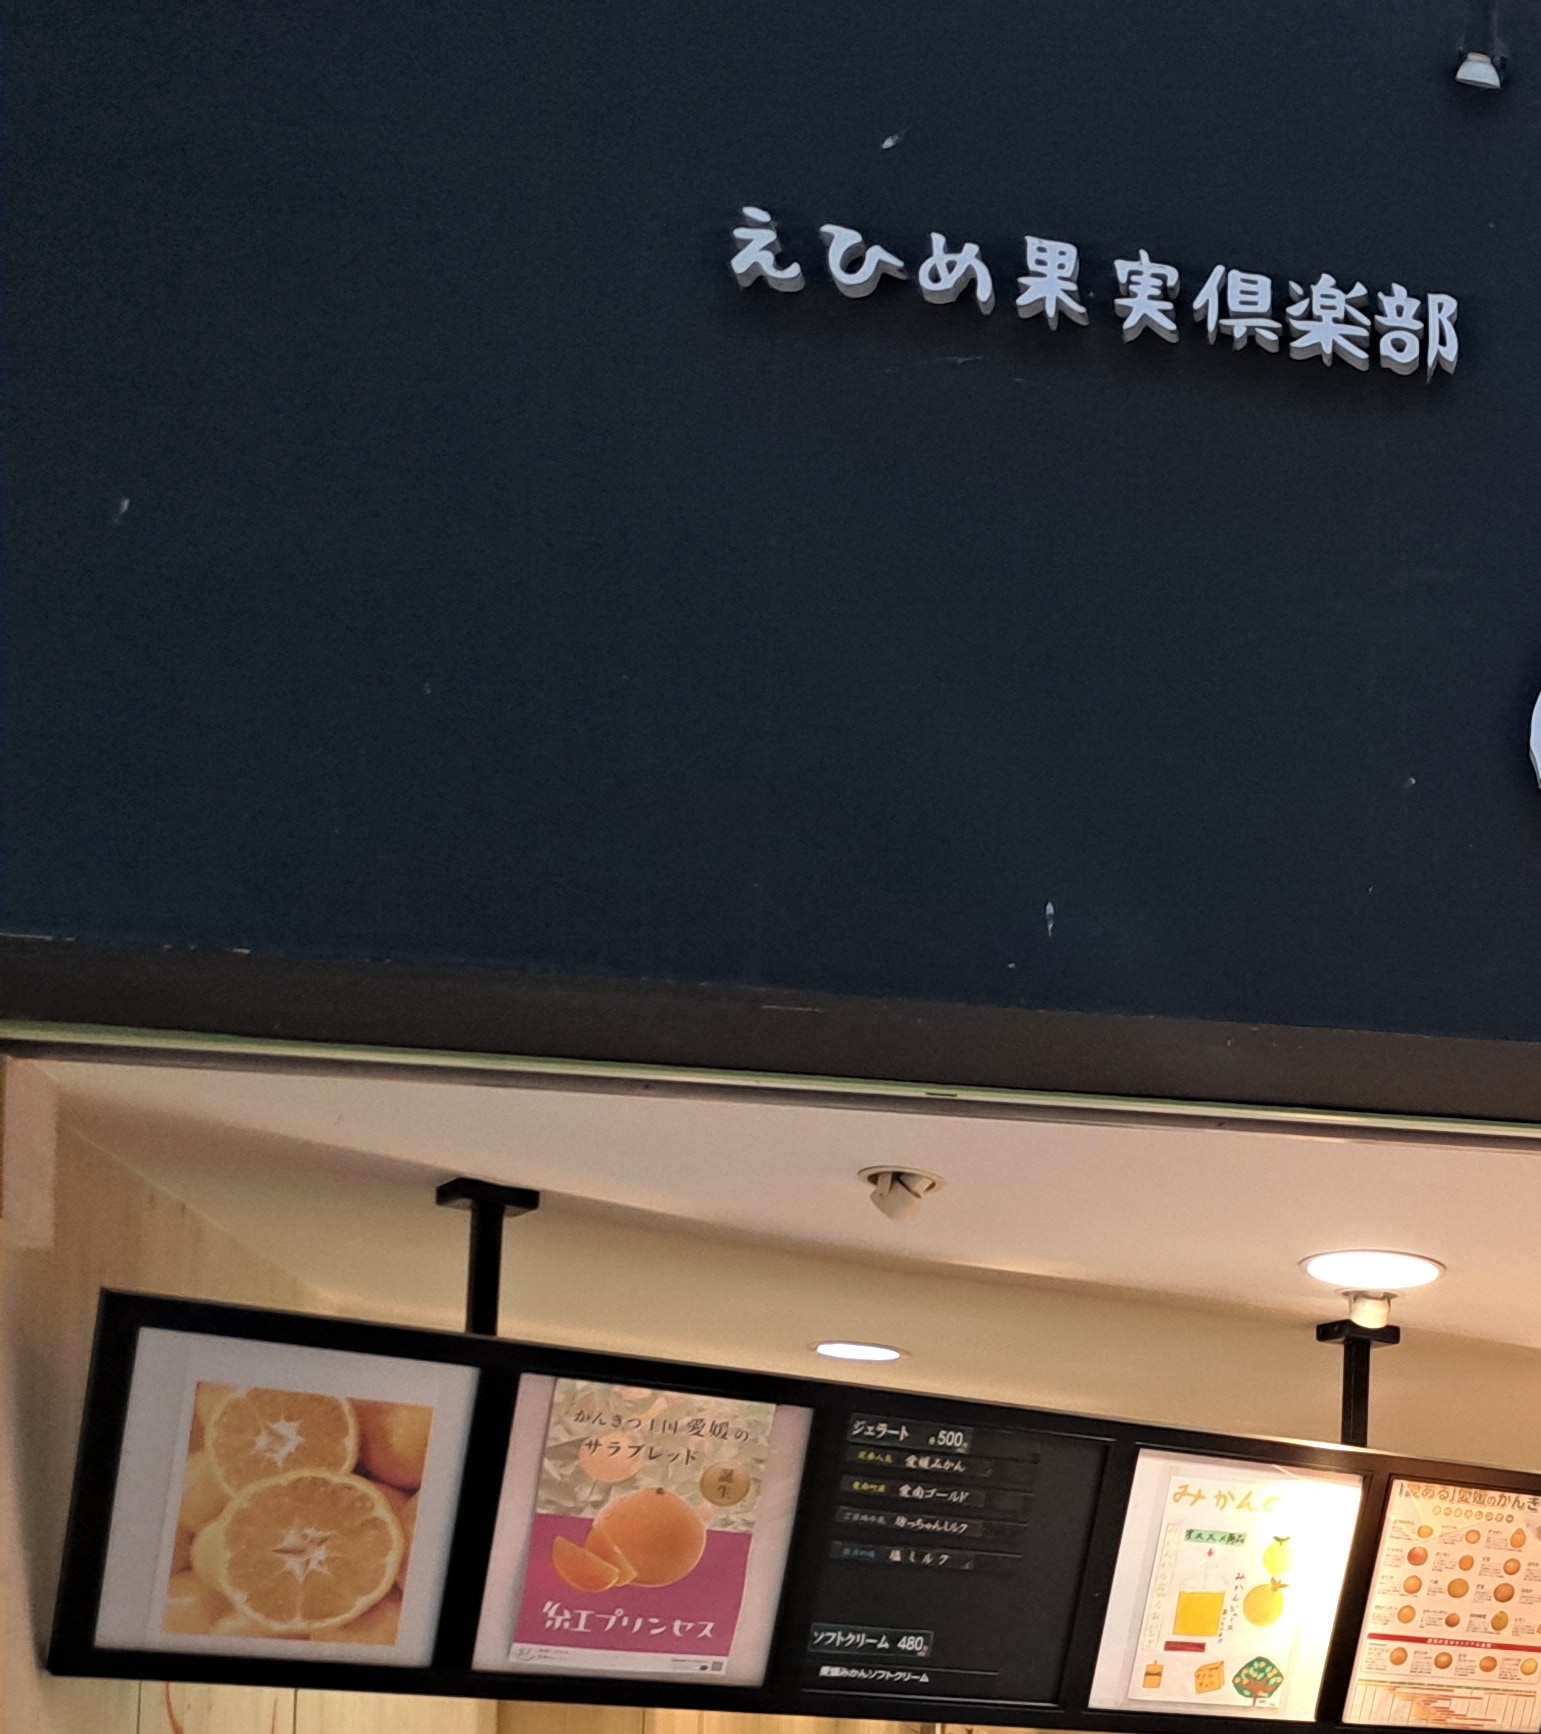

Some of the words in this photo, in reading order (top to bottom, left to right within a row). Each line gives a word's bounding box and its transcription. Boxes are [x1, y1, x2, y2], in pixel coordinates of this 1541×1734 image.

[729, 206, 1459, 384] えひめ果実倶楽部
[851, 1419, 909, 1442] ジェラート
[584, 1438, 699, 1466] サラブレッド
[899, 1483, 970, 1503] 愛南ゴールド
[542, 1600, 716, 1639] 紅プリンセス
[813, 1631, 890, 1650] ソフトクリーム
